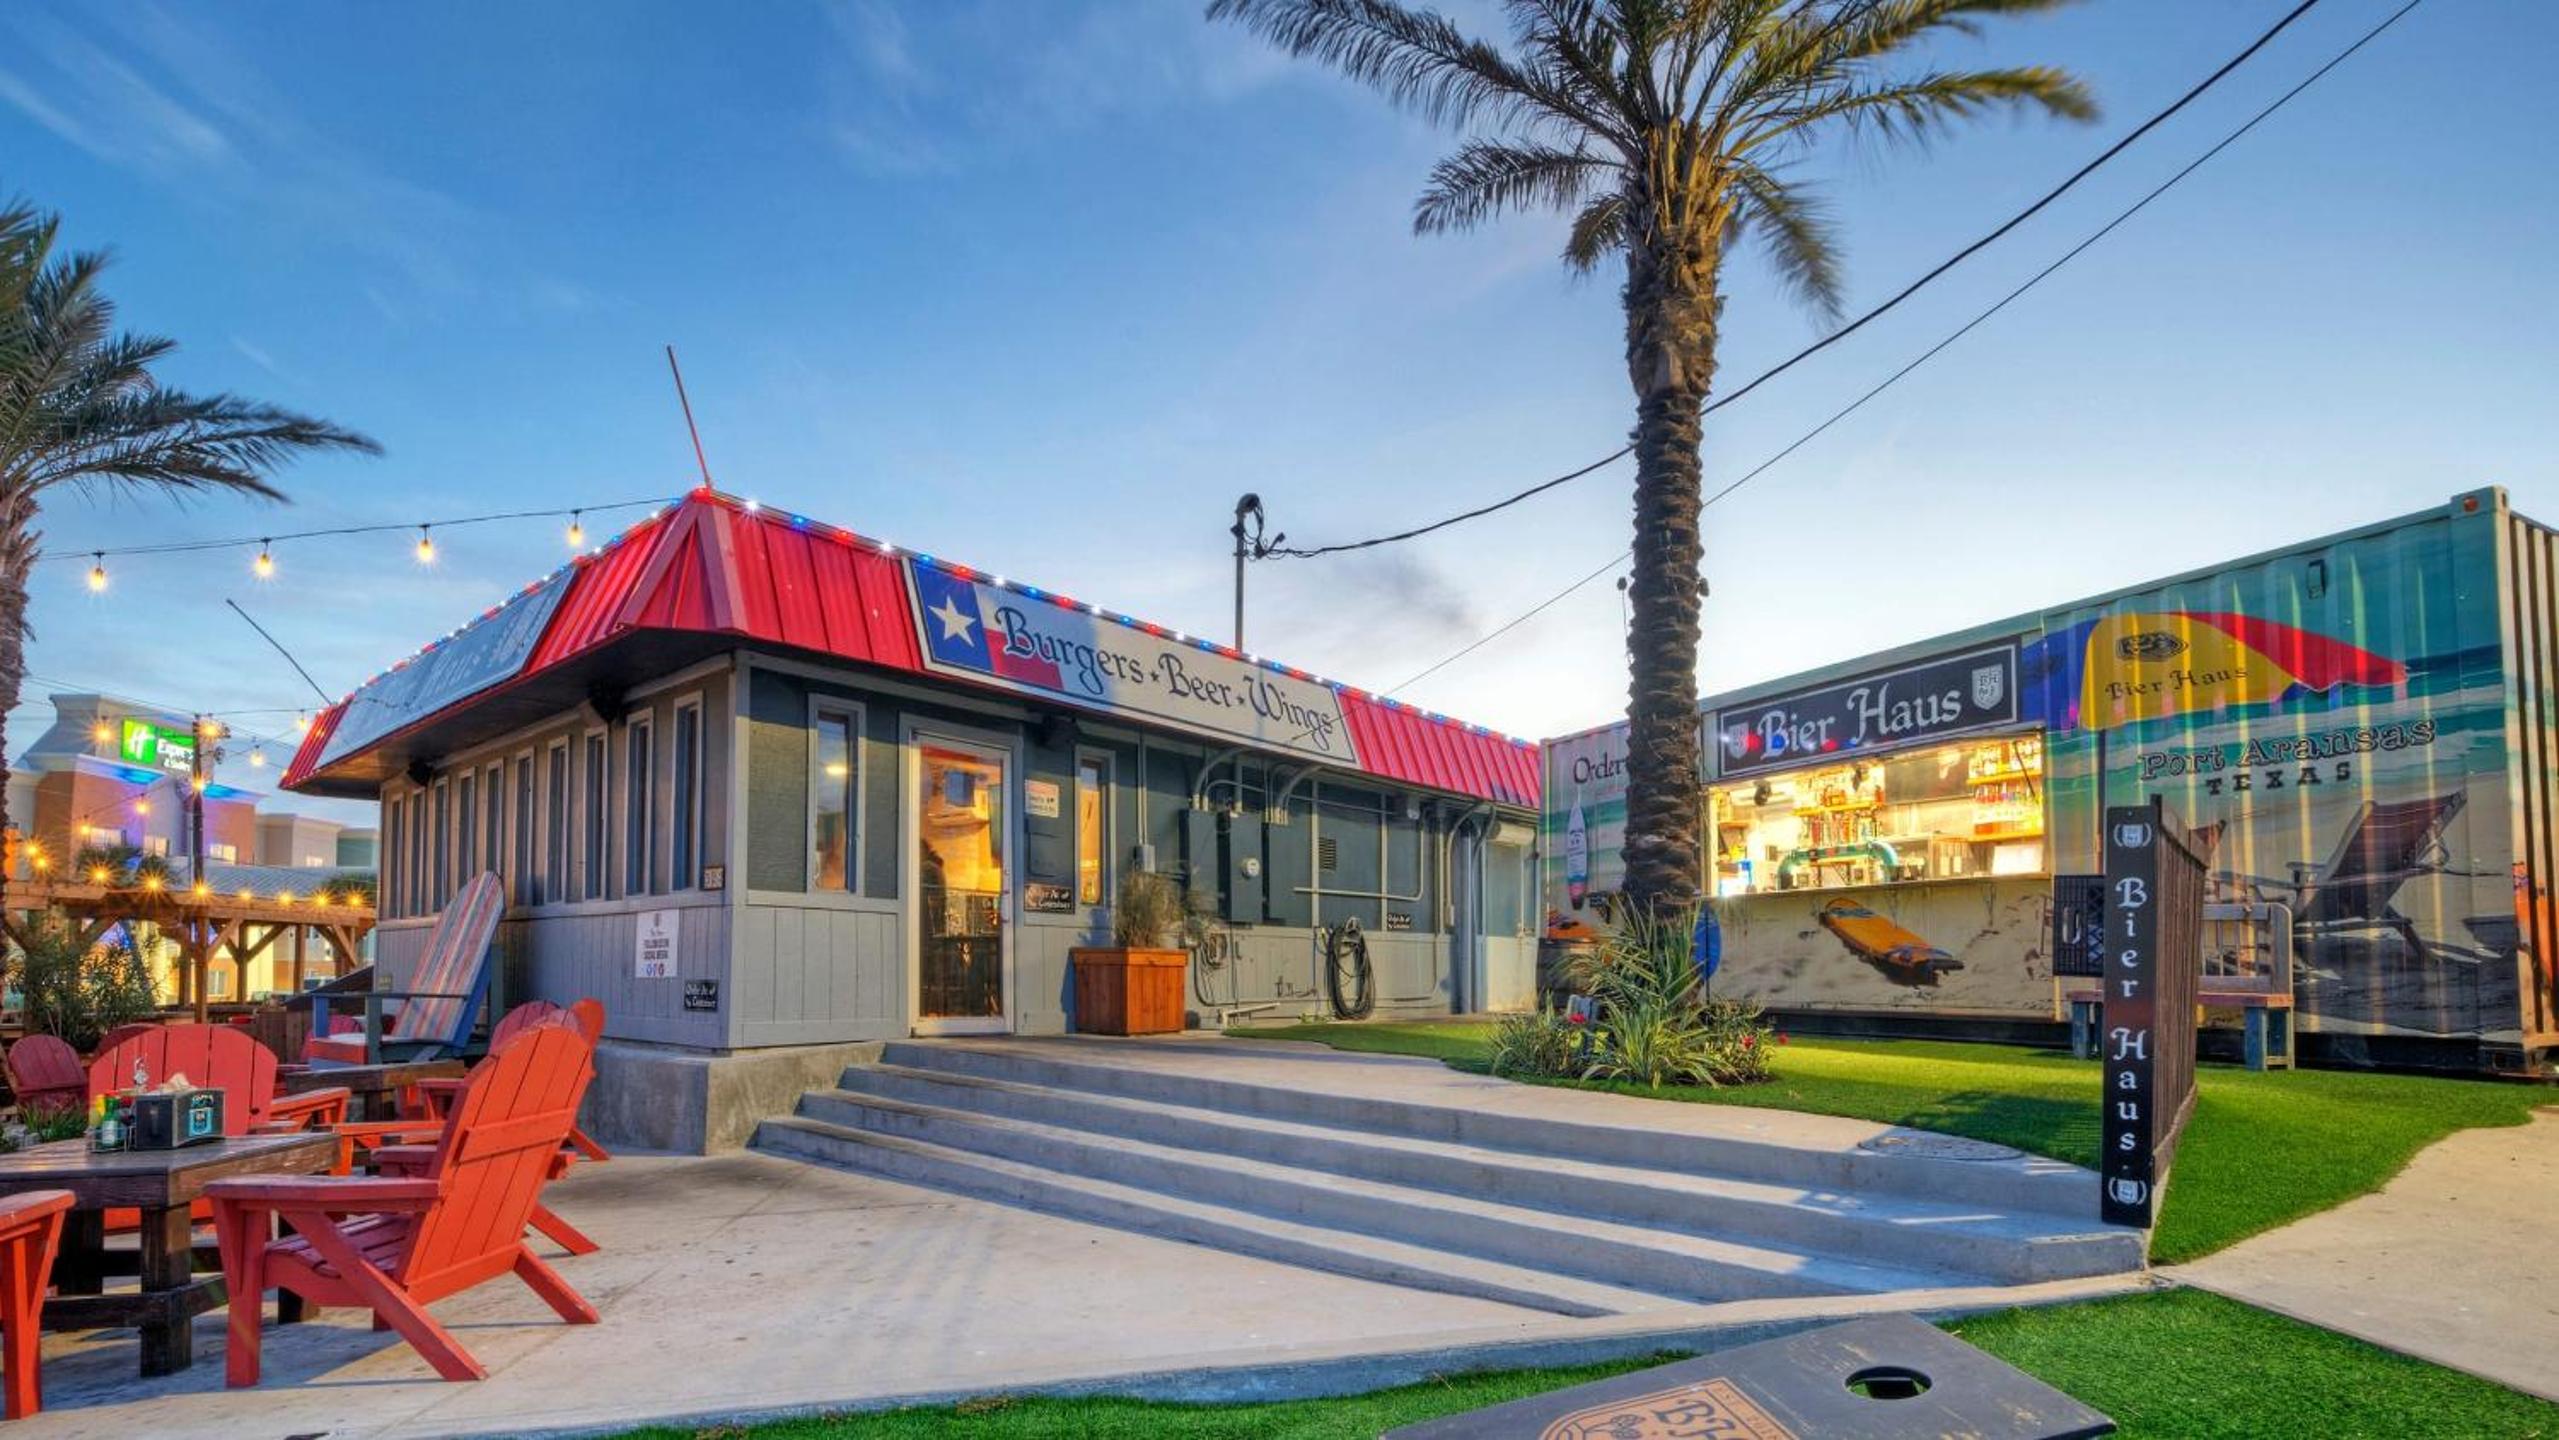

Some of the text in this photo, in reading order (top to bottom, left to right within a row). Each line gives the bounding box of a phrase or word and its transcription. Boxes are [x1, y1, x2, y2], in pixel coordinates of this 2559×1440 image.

[994, 606, 1334, 751] Burgers Beer Wings
[2105, 669, 2248, 700] Bier Haus
[1757, 709, 1836, 761] Bier
[1846, 681, 1962, 744] Haus
[2139, 718, 2437, 781] Port Aransas
[2205, 761, 2352, 796] TEXAS
[2110, 876, 2148, 1151] Bier Haus
